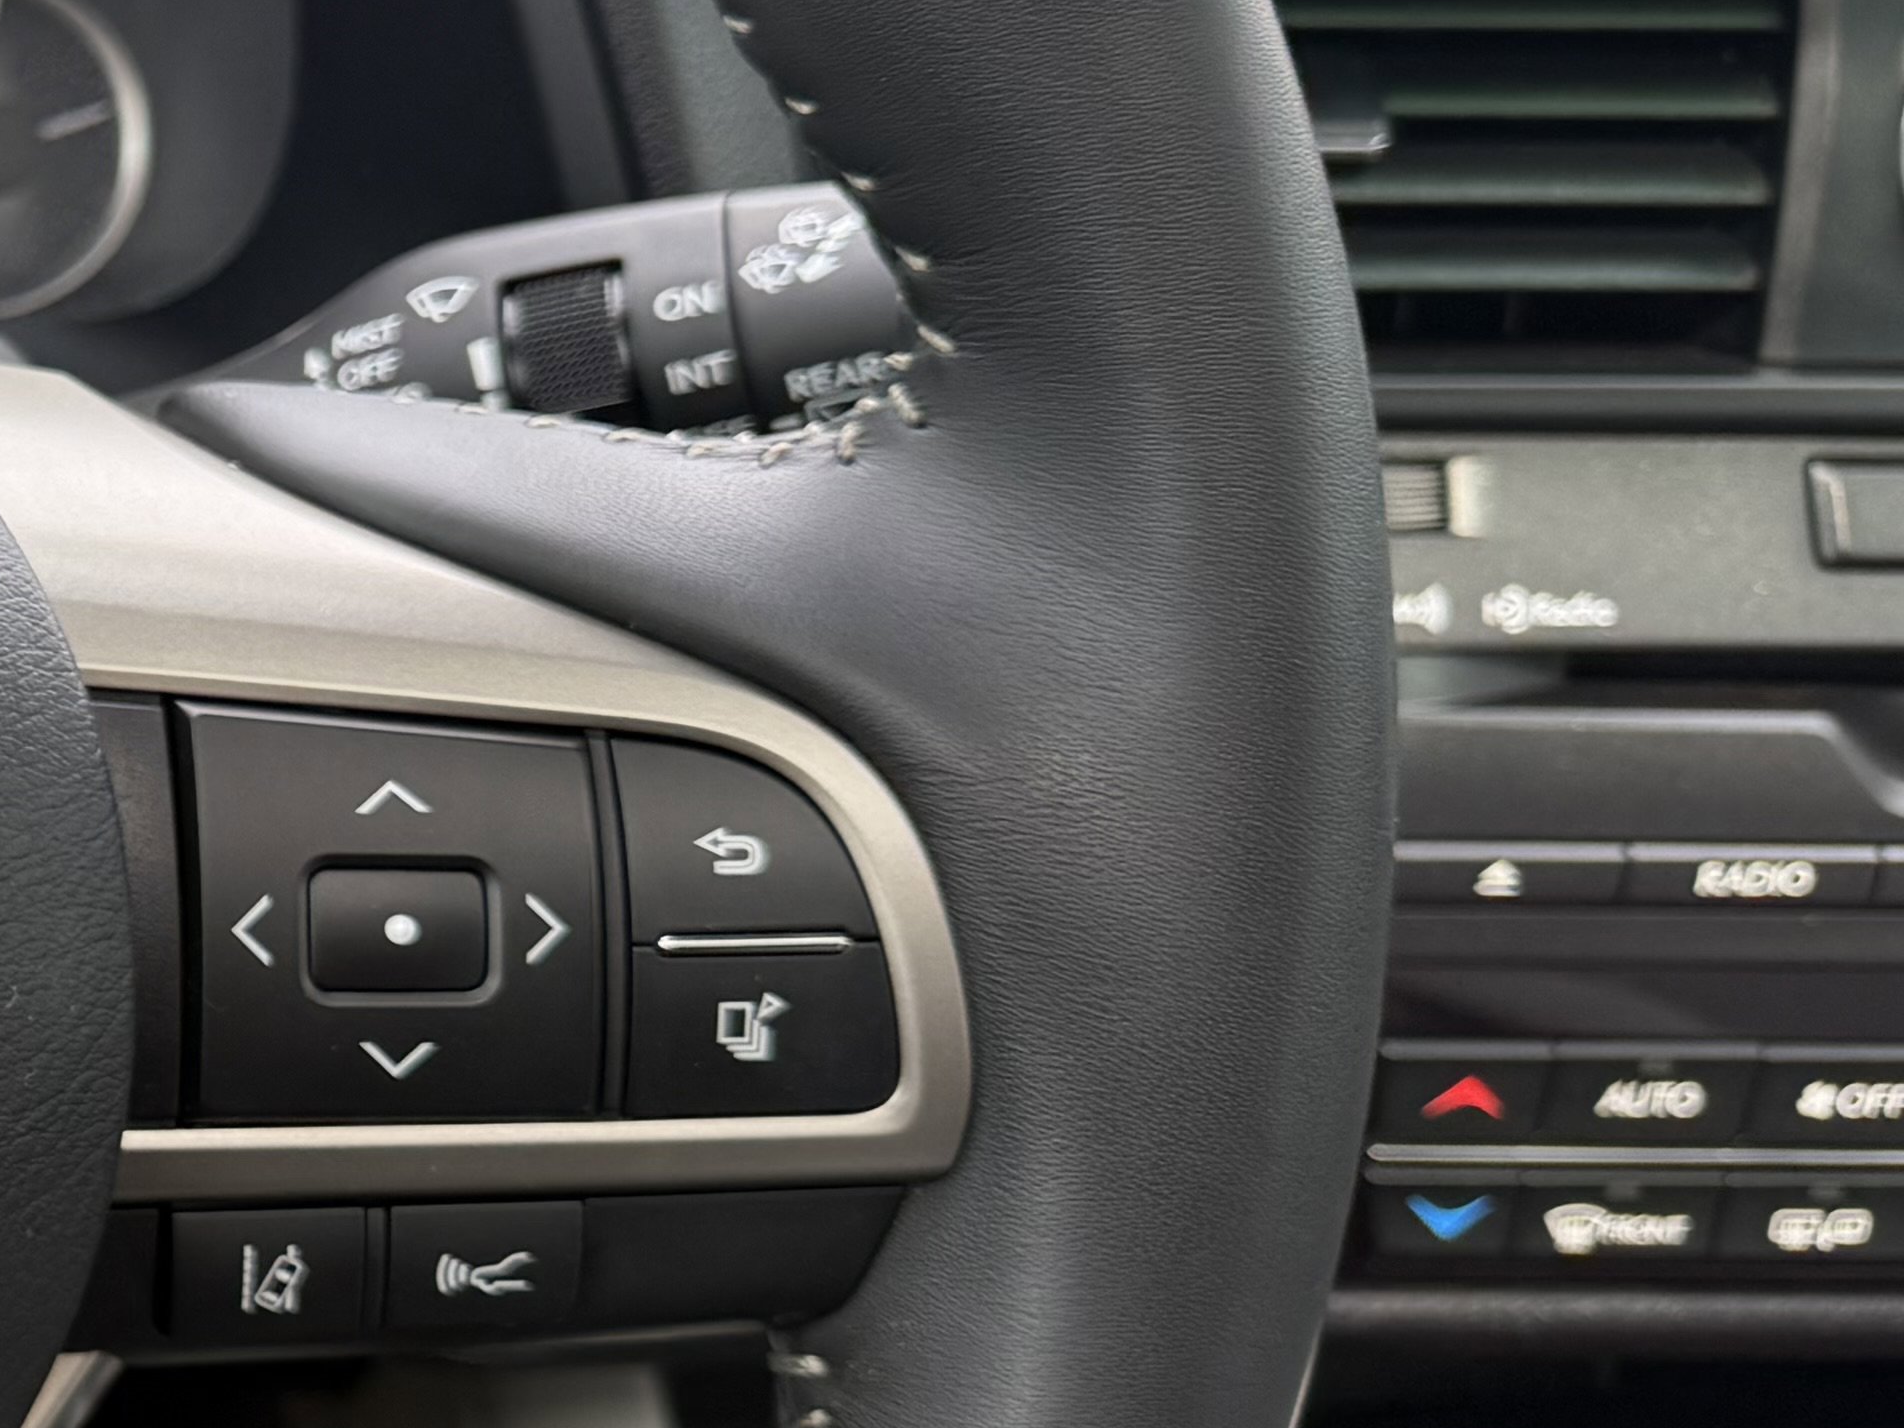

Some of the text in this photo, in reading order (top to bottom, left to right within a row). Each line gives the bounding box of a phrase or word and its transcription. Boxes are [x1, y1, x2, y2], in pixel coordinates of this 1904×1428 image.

[653, 280, 723, 322] ON
[664, 349, 737, 395] INT
[784, 351, 888, 403] REAR
[1694, 860, 1818, 897] RADIO
[1594, 1080, 1709, 1119] AUTO
